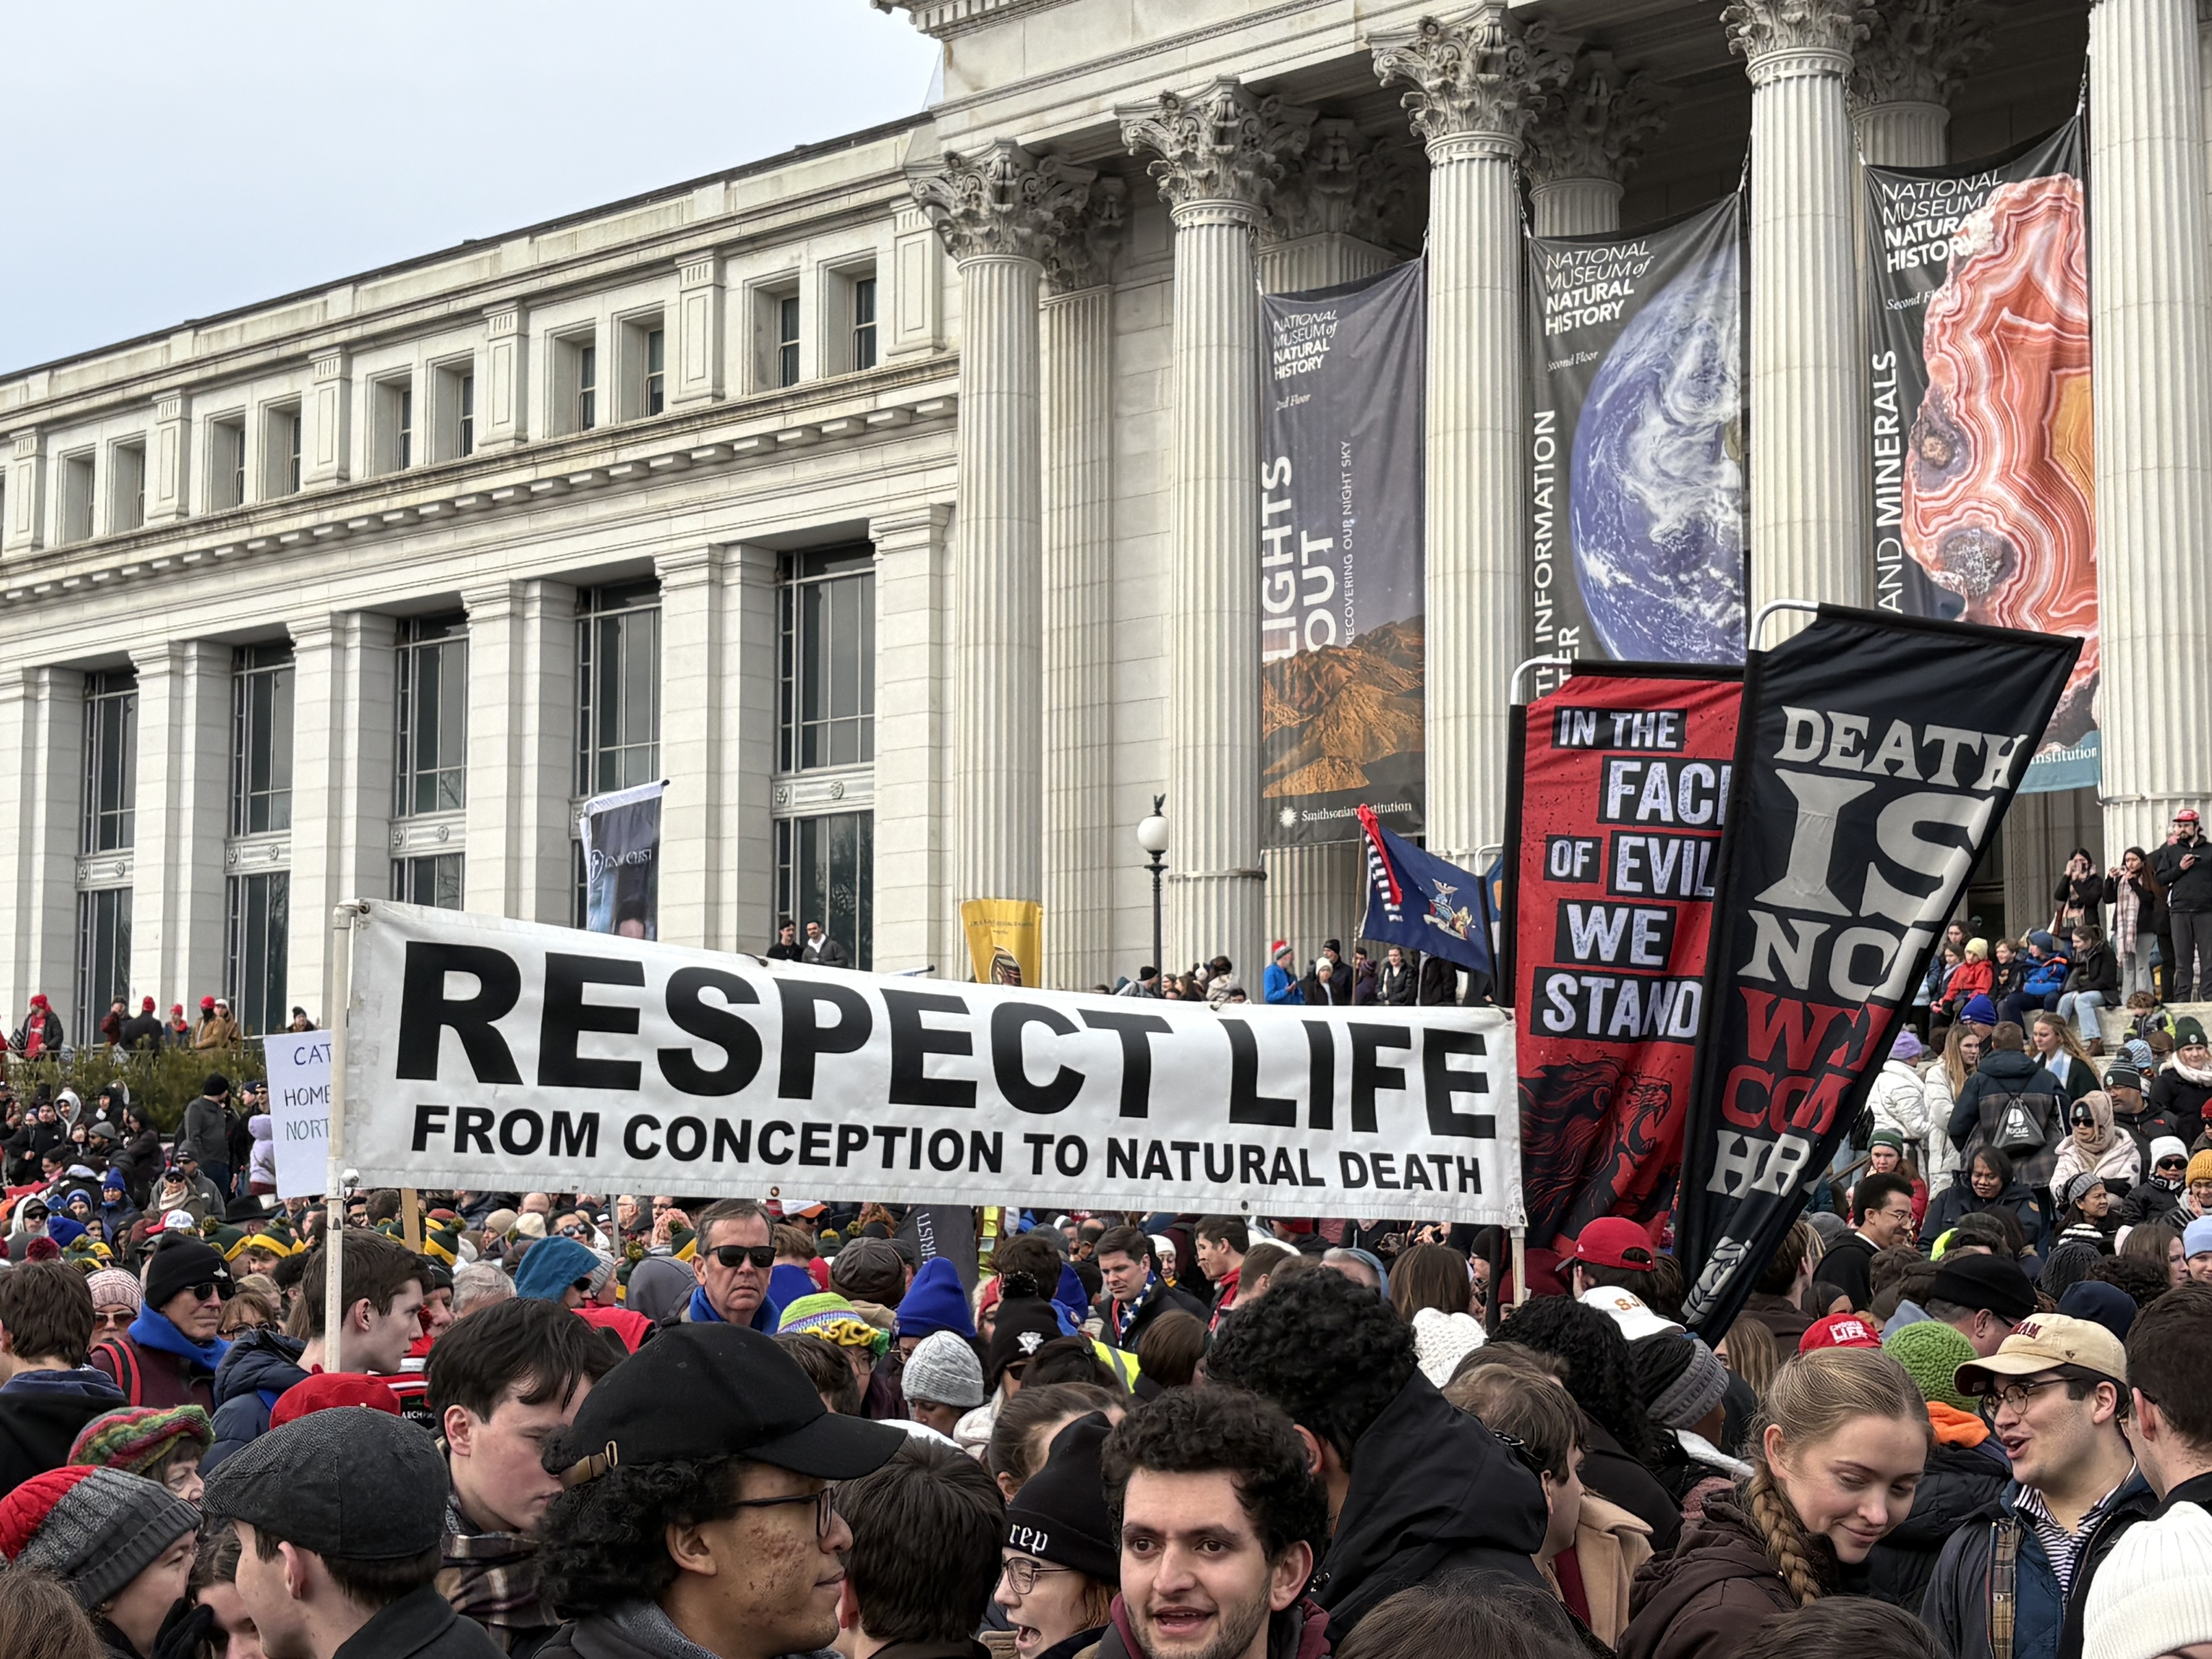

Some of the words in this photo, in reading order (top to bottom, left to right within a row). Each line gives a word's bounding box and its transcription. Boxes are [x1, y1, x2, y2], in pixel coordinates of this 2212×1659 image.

[1882, 170, 2003, 203] NATIONAL
[1883, 192, 1983, 225] MUSEUM
[1884, 211, 1980, 249] NATURA
[1546, 241, 1650, 271] NATIONAL
[1887, 234, 1977, 273] HISTORY
[1546, 261, 1632, 291] MUSEUM
[1632, 256, 1654, 278] of
[1546, 278, 1634, 314] NATURAL
[1886, 292, 1920, 310] Second
[1274, 309, 1337, 332] NATIONAL
[1274, 323, 1325, 349] MUSEUM
[1326, 320, 1340, 338] of
[1546, 300, 1625, 336] HISTORY
[1274, 338, 1330, 365] NATURAL
[1274, 354, 1324, 380] HISTORY
[1576, 350, 1598, 364] Floor
[1341, 441, 1351, 467] SKY
[1872, 350, 1903, 533] MINERALS
[1341, 472, 1352, 515] NIGHT
[1343, 519, 1353, 550] OUR
[1534, 410, 1555, 644] INFORMATION
[1262, 456, 1297, 663] LIGHTS
[1878, 537, 1903, 615] AND
[1301, 530, 1336, 652] OUT
[1343, 553, 1355, 647] RECOVERING
[1559, 710, 1596, 746] IN
[1610, 711, 1679, 748] THE
[1773, 706, 2028, 790] DEATH
[1301, 806, 1358, 822] Smithsonian
[1550, 839, 1593, 878] OF
[1615, 836, 1716, 897] EVIL
[1754, 768, 1995, 927] IS
[1567, 904, 1668, 965] WE
[1543, 973, 1703, 1038] STAND
[396, 941, 1174, 1118] RESPECT
[1216, 1018, 1496, 1139] LIFE
[411, 1104, 599, 1158] FROM
[623, 1114, 1003, 1173] CONCEPTION
[1024, 1133, 1087, 1176] TO
[1106, 1137, 1325, 1187] NATURAL
[1338, 1151, 1482, 1194] DEATH
[917, 1212, 936, 1264] HRISTI
[1009, 1523, 1048, 1554] rep
